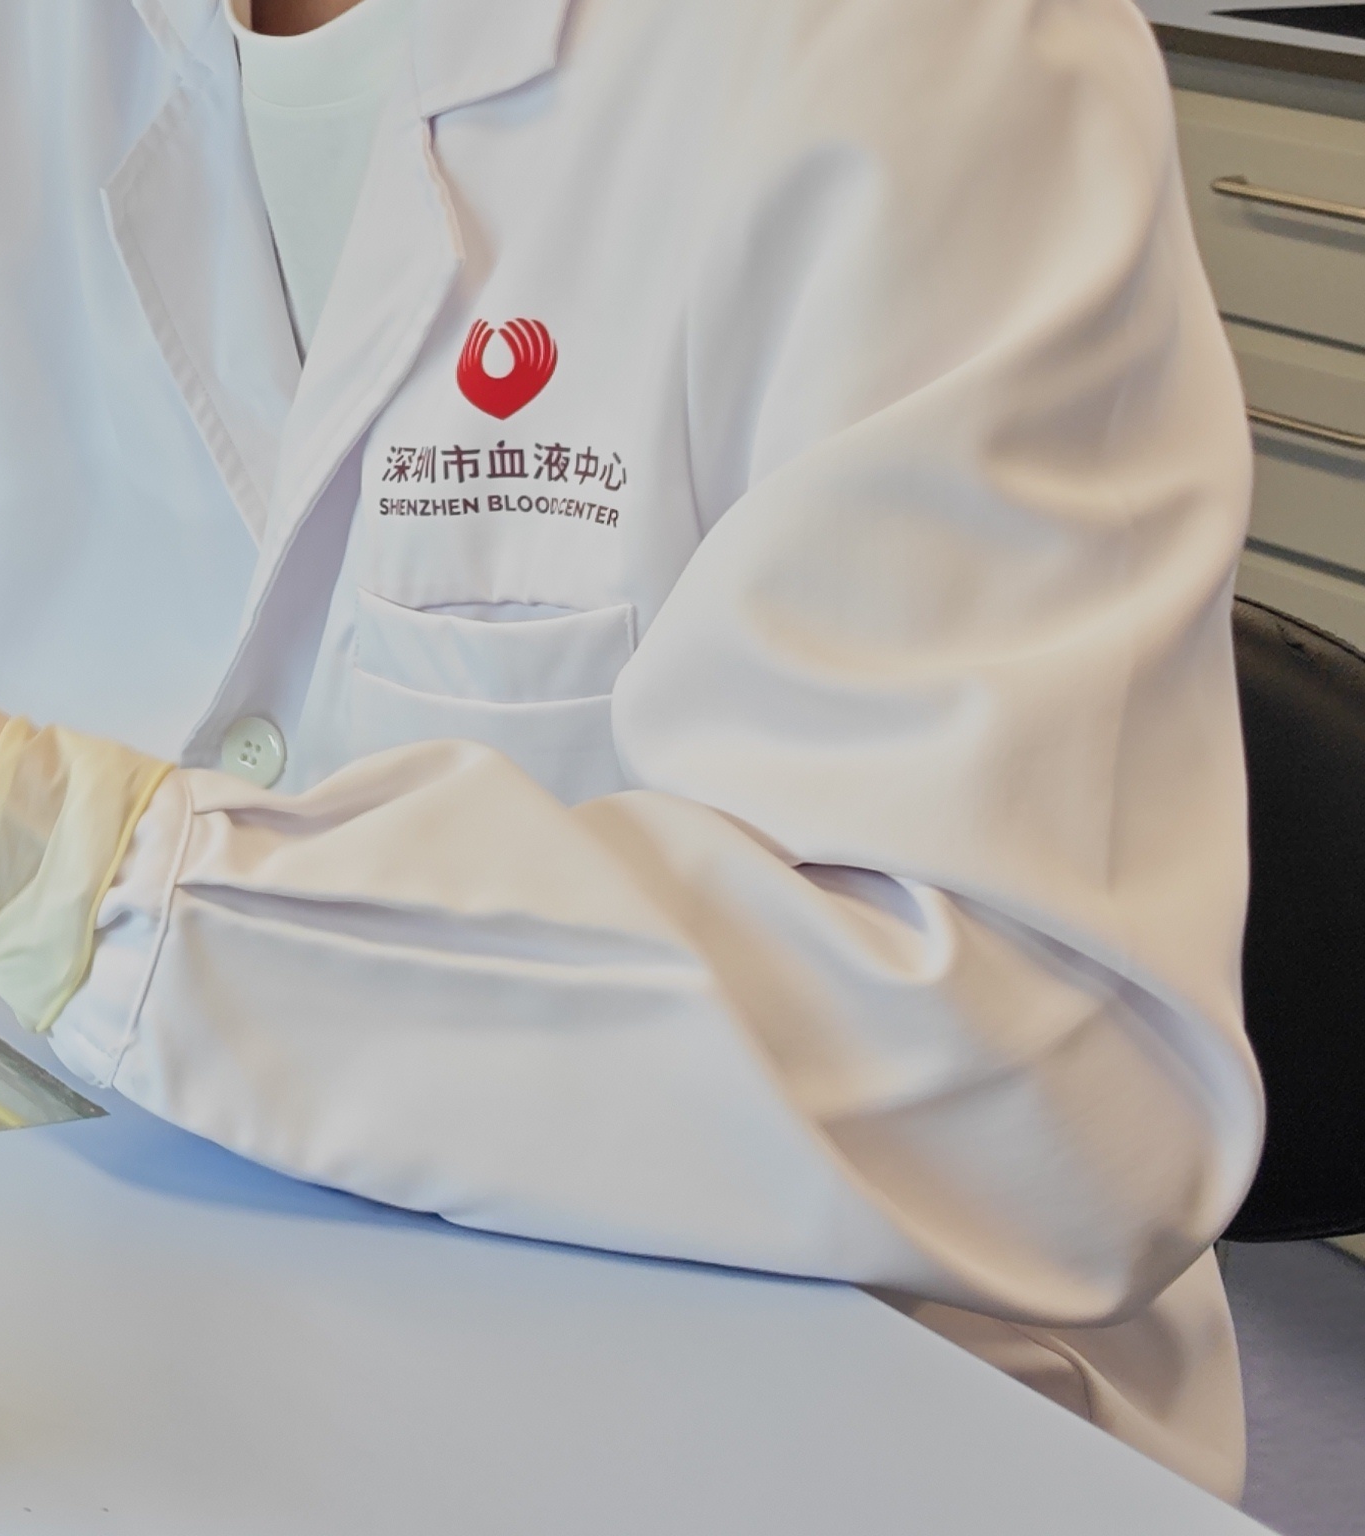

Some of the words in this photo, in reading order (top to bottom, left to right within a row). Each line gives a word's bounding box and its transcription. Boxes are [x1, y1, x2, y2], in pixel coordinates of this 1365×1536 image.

[381, 440, 627, 492] 深圳市血液中心
[379, 497, 480, 516] SHENZHEN
